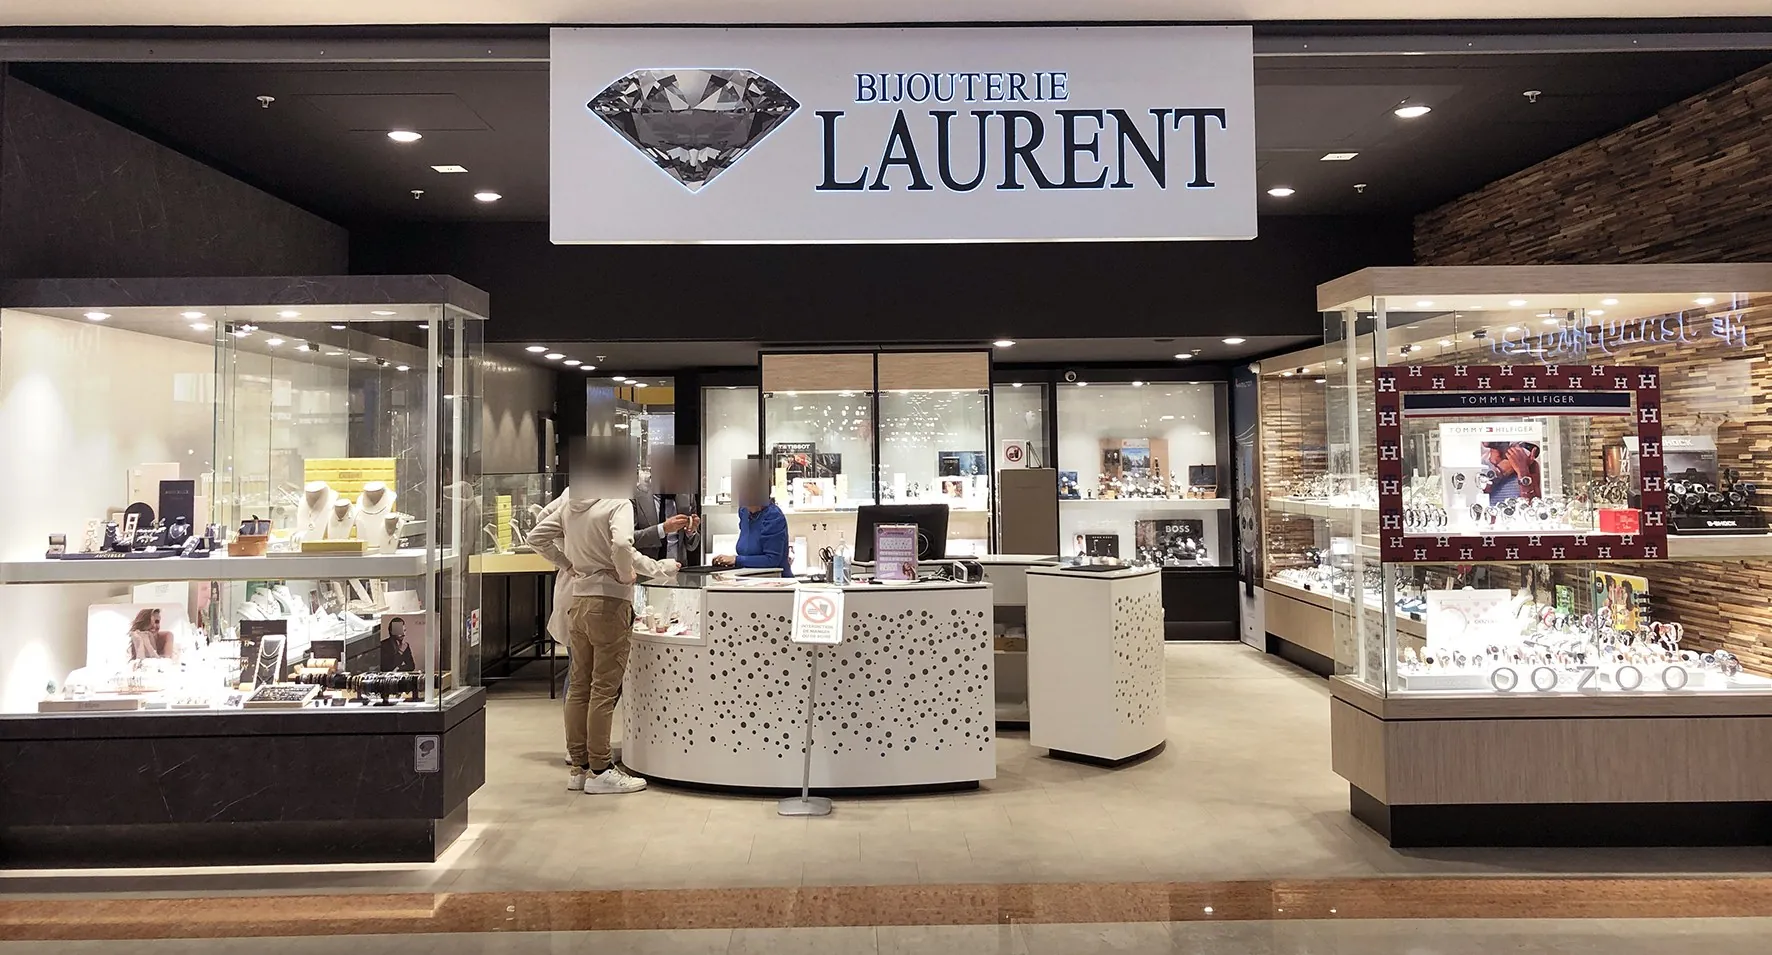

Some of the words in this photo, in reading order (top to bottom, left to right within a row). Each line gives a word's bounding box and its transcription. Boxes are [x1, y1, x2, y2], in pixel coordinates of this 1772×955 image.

[854, 72, 1070, 104] BIJOUTERIE
[813, 107, 1227, 193] LAURENT
[1460, 396, 1507, 405] TOMMY
[1523, 395, 1576, 404] HILFIGER
[1165, 524, 1190, 533] BOSS
[1490, 664, 1689, 693] OOZOO
